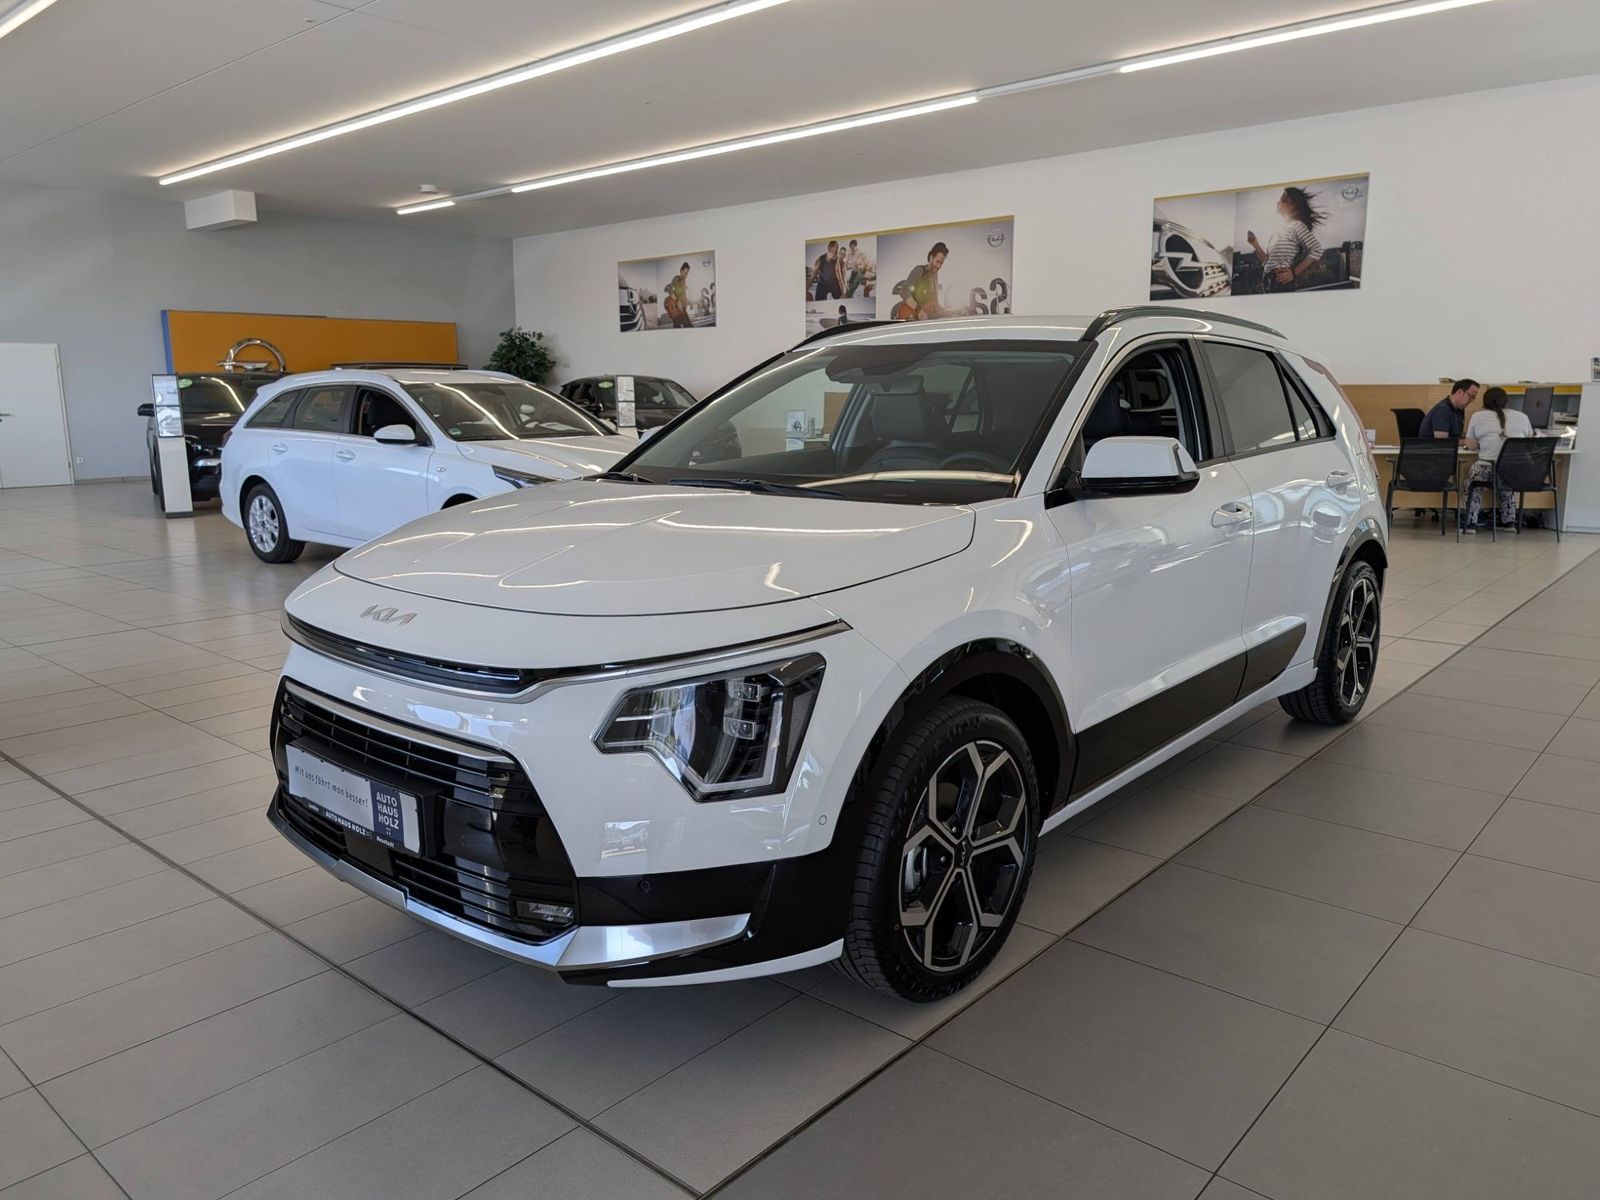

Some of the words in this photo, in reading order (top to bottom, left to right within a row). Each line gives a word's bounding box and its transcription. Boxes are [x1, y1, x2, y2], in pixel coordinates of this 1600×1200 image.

[305, 772, 314, 782] uns
[332, 784, 344, 796] man
[345, 789, 368, 808] besser!
[376, 791, 398, 807] AUTO
[377, 802, 399, 818] HAUS
[352, 823, 366, 836] HOLZ
[378, 813, 399, 830] HOLZ
